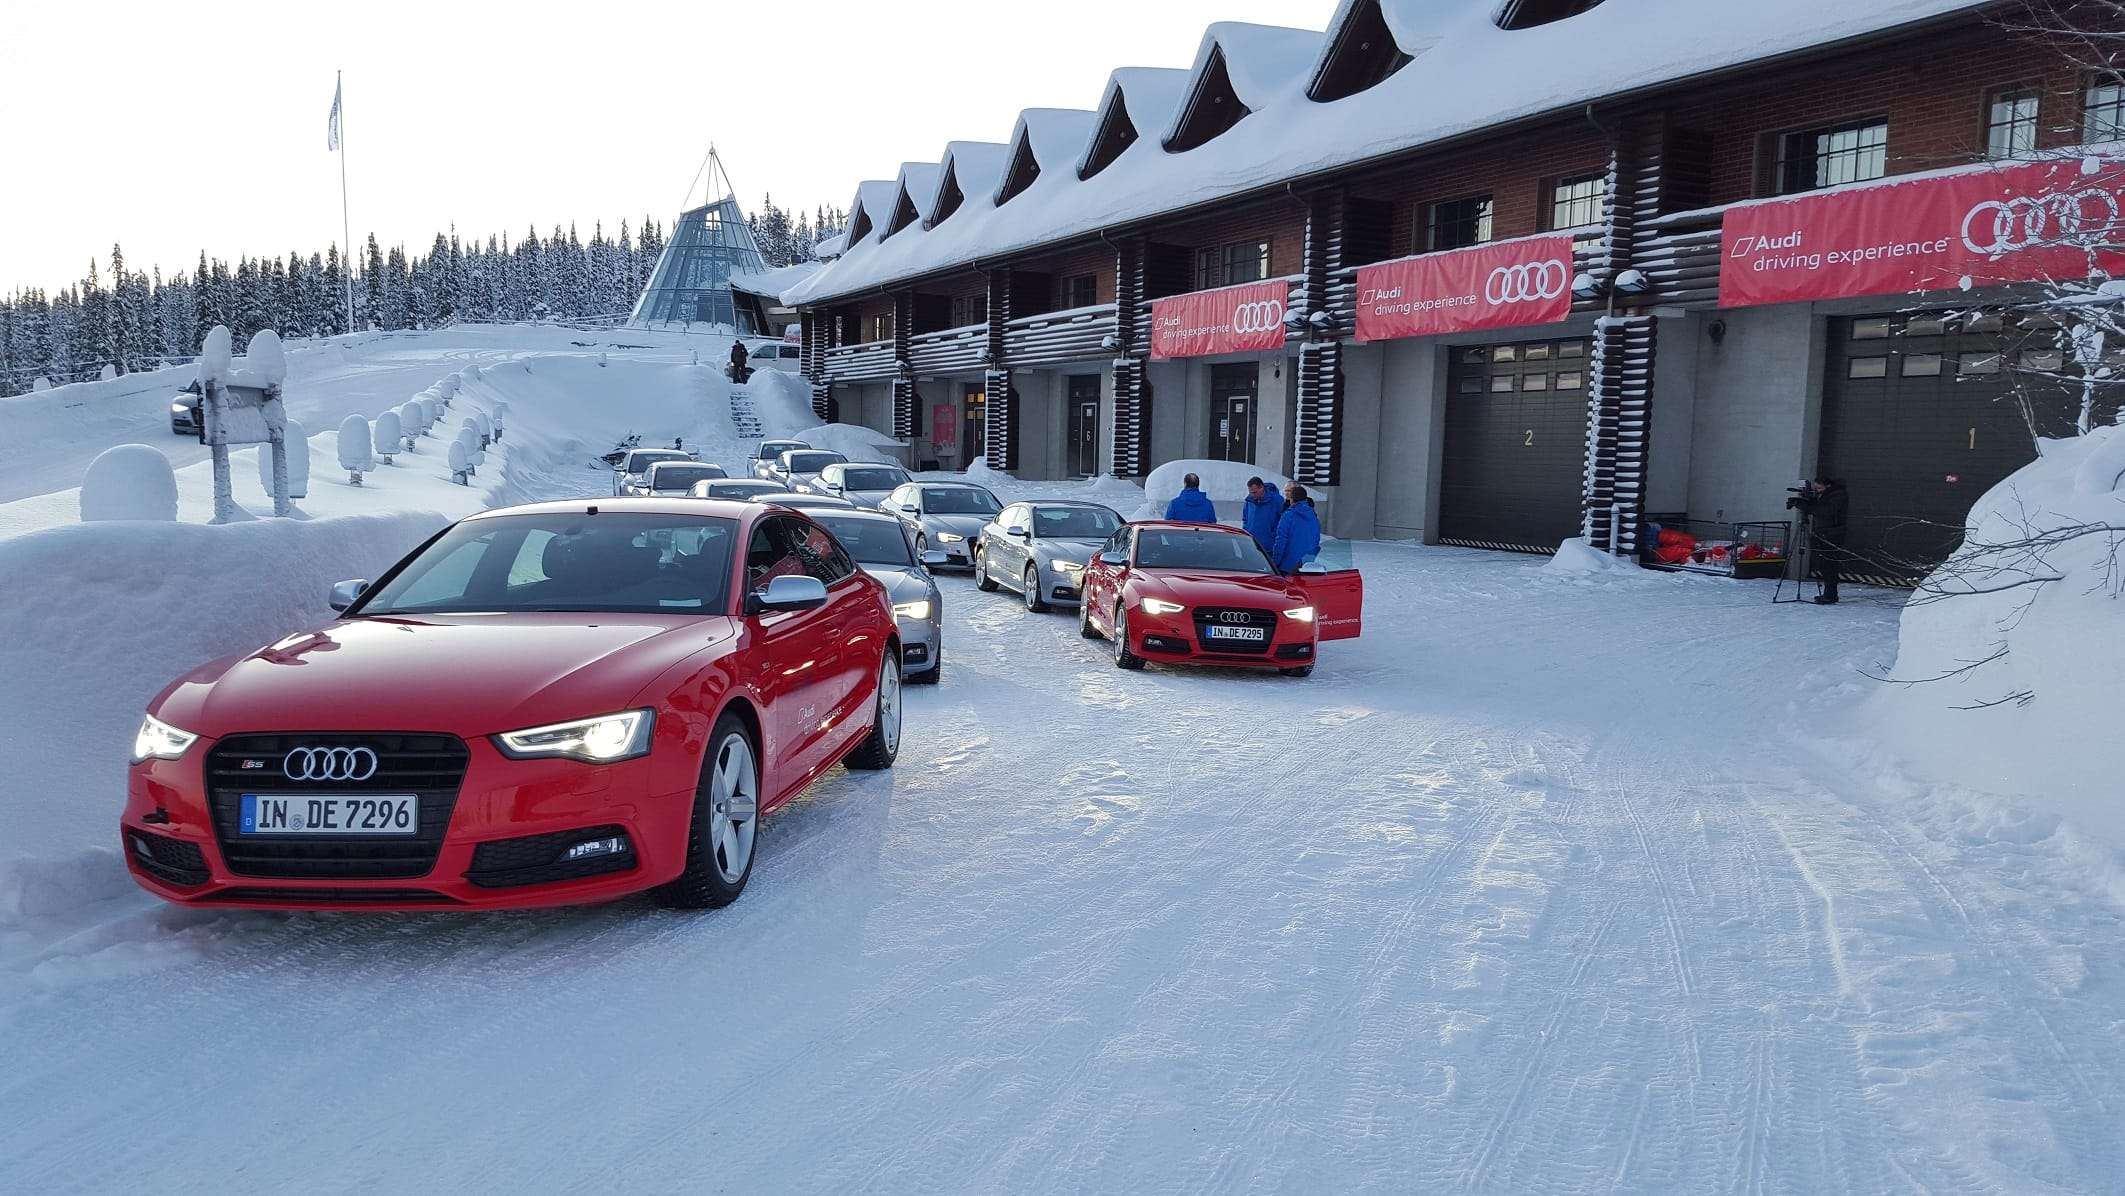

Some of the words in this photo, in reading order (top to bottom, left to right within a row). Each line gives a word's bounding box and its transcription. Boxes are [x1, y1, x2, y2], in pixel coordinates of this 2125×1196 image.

[1755, 231, 1802, 251] Audi
[1754, 252, 1820, 271] driving
[1827, 239, 1948, 265] experience
[1376, 287, 1401, 300] Audi
[1375, 302, 1410, 315] driving
[1413, 295, 1477, 312] experience
[1163, 316, 1181, 327] Audi
[1163, 329, 1187, 339] driving
[1188, 324, 1230, 337] experience
[1086, 430, 1091, 441] 6
[1525, 429, 1533, 445] 2
[1969, 427, 1976, 449] 1
[1213, 627, 1224, 637] IN
[1229, 628, 1240, 638] DE
[1241, 629, 1262, 639] 7295
[259, 800, 288, 829] IN
[306, 800, 338, 829] DE
[345, 800, 410, 829] 7296
